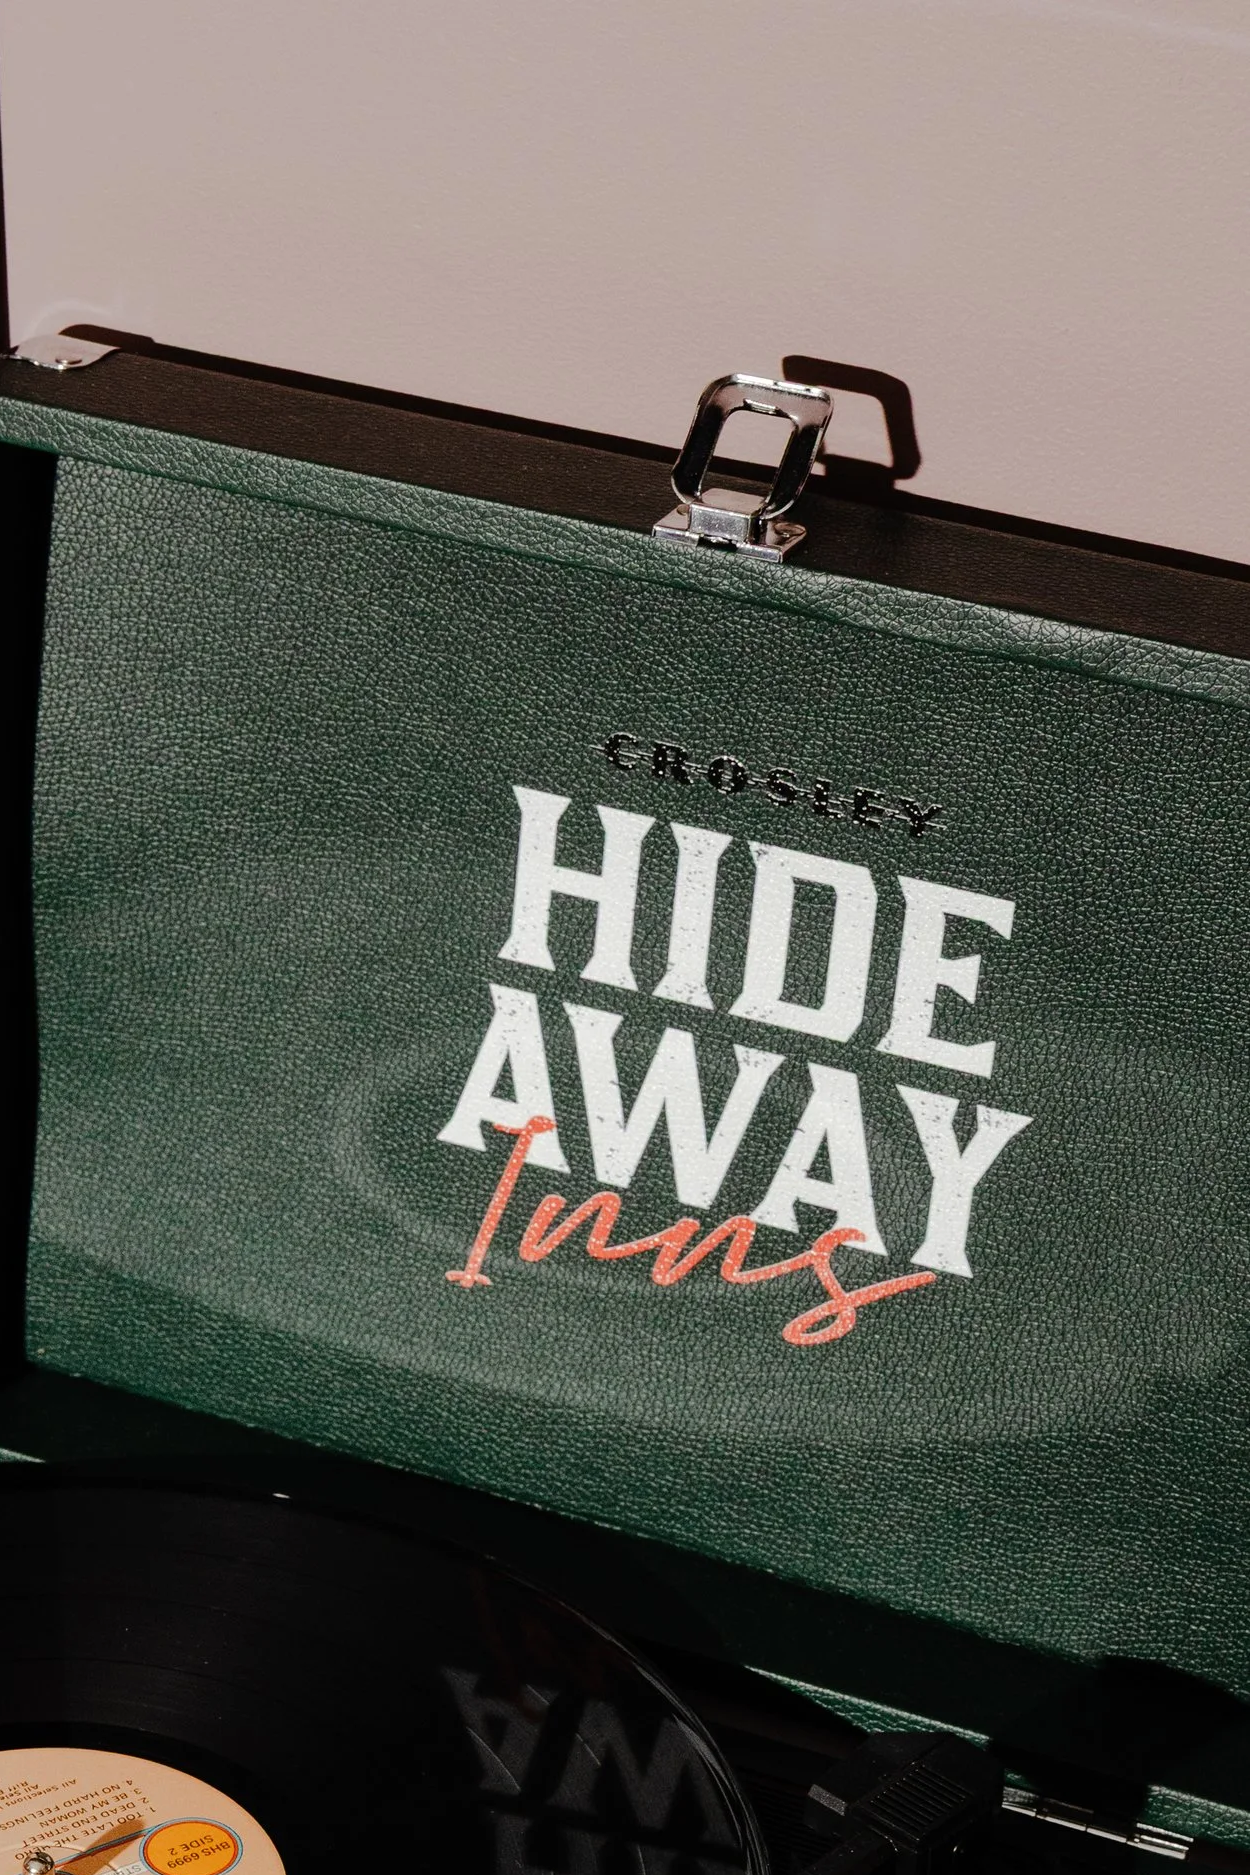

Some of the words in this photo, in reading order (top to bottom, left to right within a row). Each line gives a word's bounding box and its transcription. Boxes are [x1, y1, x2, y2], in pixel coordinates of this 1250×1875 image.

[600, 731, 944, 837] CROSLEY
[497, 785, 1016, 1078] HIDE
[436, 983, 1034, 1278] AWAY
[445, 1115, 937, 1345] Inns
[6, 1779, 29, 1791] Riff
[23, 1783, 39, 1794] All
[61, 1778, 77, 1788] All
[100, 1783, 121, 1795] NO
[4, 1784, 59, 1808] Selections
[62, 1791, 99, 1809] HARD
[90, 1798, 108, 1810] MY
[111, 1792, 129, 1802] BE
[38, 1806, 87, 1829] WOMAN
[99, 1801, 136, 1819] DEAD
[116, 1810, 143, 1825] TOO
[71, 1814, 98, 1829] END
[79, 1820, 114, 1839] LATE
[20, 1824, 69, 1848] STREET
[53, 1833, 78, 1848] THE
[180, 1834, 214, 1852] SIDE
[167, 1846, 178, 1856] 2
[200, 1840, 231, 1858] BHS
[166, 1851, 200, 1869] 6999
